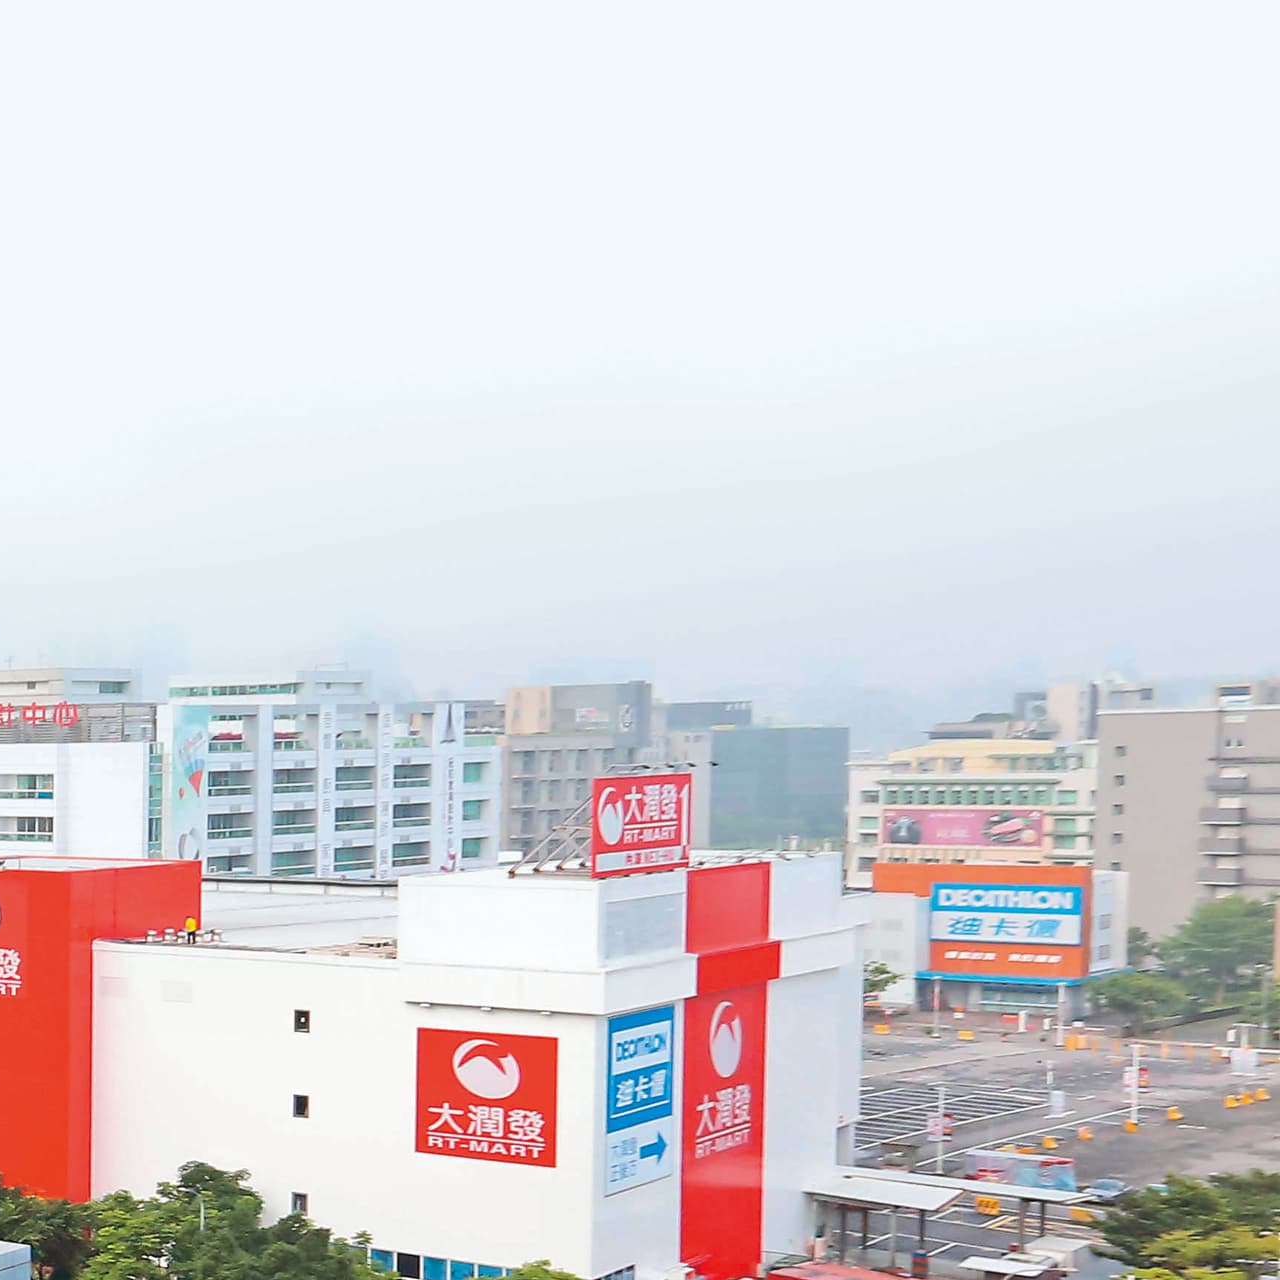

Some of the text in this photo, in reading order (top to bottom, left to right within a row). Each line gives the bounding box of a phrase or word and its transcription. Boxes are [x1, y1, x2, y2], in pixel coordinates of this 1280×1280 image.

[623, 783, 677, 823] 大潤發
[623, 826, 677, 844] RT-MART
[938, 888, 1074, 910] DECATHLON
[615, 1032, 667, 1063] DECATHLON
[427, 1101, 546, 1143] 大潤發
[695, 1084, 752, 1137] 大潤發
[427, 1135, 546, 1159] RT-MART
[695, 1128, 752, 1159] RT-MART
